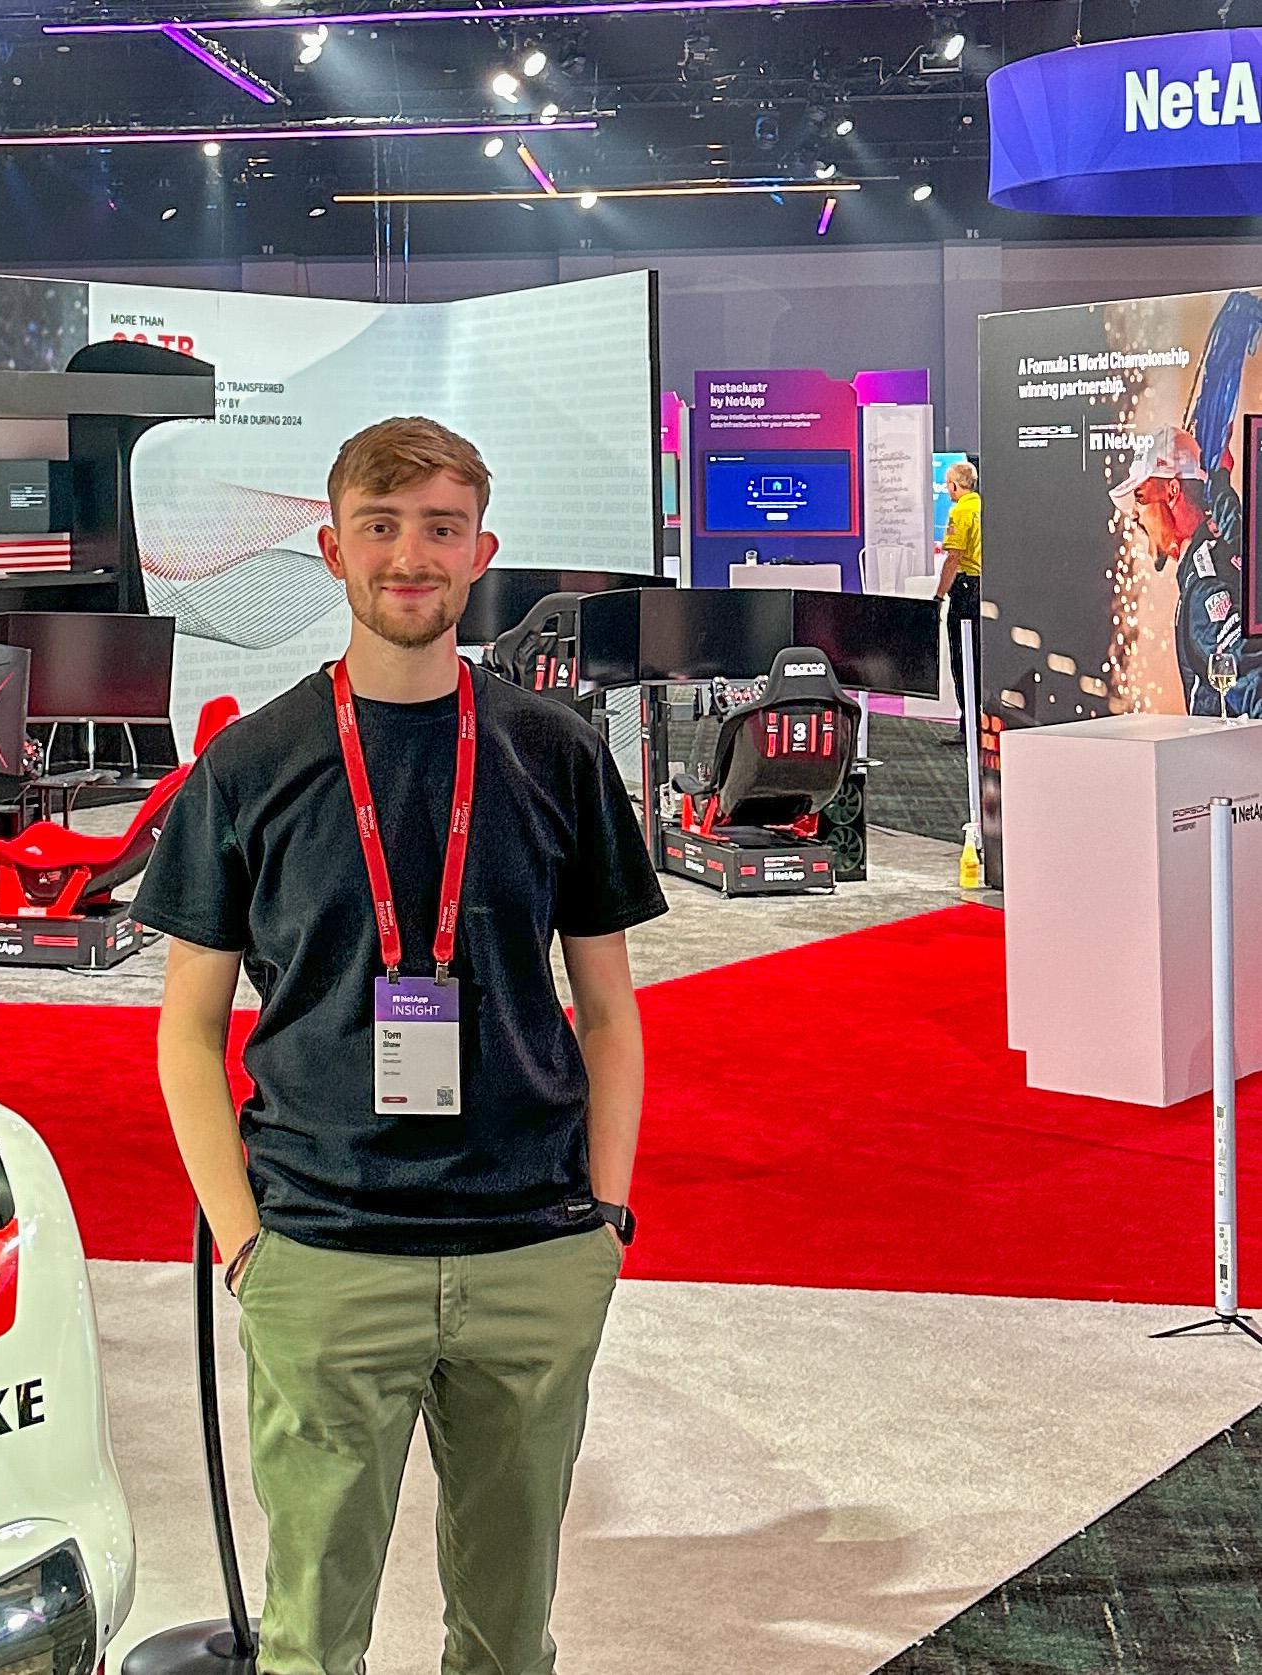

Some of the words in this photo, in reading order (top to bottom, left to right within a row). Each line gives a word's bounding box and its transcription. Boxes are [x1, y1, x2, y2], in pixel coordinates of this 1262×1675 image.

[1125, 61, 1262, 133] NetA
[110, 314, 137, 326] MORE
[139, 315, 164, 327] THAN
[1018, 358, 1026, 375] A
[1027, 356, 1069, 375] Formula
[1069, 354, 1078, 372] E
[1078, 352, 1109, 371] World
[1109, 346, 1190, 371] Championship
[227, 382, 285, 394] TRANSFERRED
[709, 382, 768, 394] Instaclustr
[1018, 380, 1059, 400] winning
[1059, 376, 1127, 399] partnership.
[710, 396, 723, 409] by
[724, 396, 765, 409] NetApp
[219, 414, 231, 425] SO
[232, 414, 249, 425] FAR
[250, 415, 280, 426] DURING
[281, 416, 302, 426] 2024
[1104, 432, 1155, 452] NetApp
[793, 722, 807, 742] 3
[392, 1005, 441, 1016] INSIGHT
[382, 1029, 402, 1040] Tom
